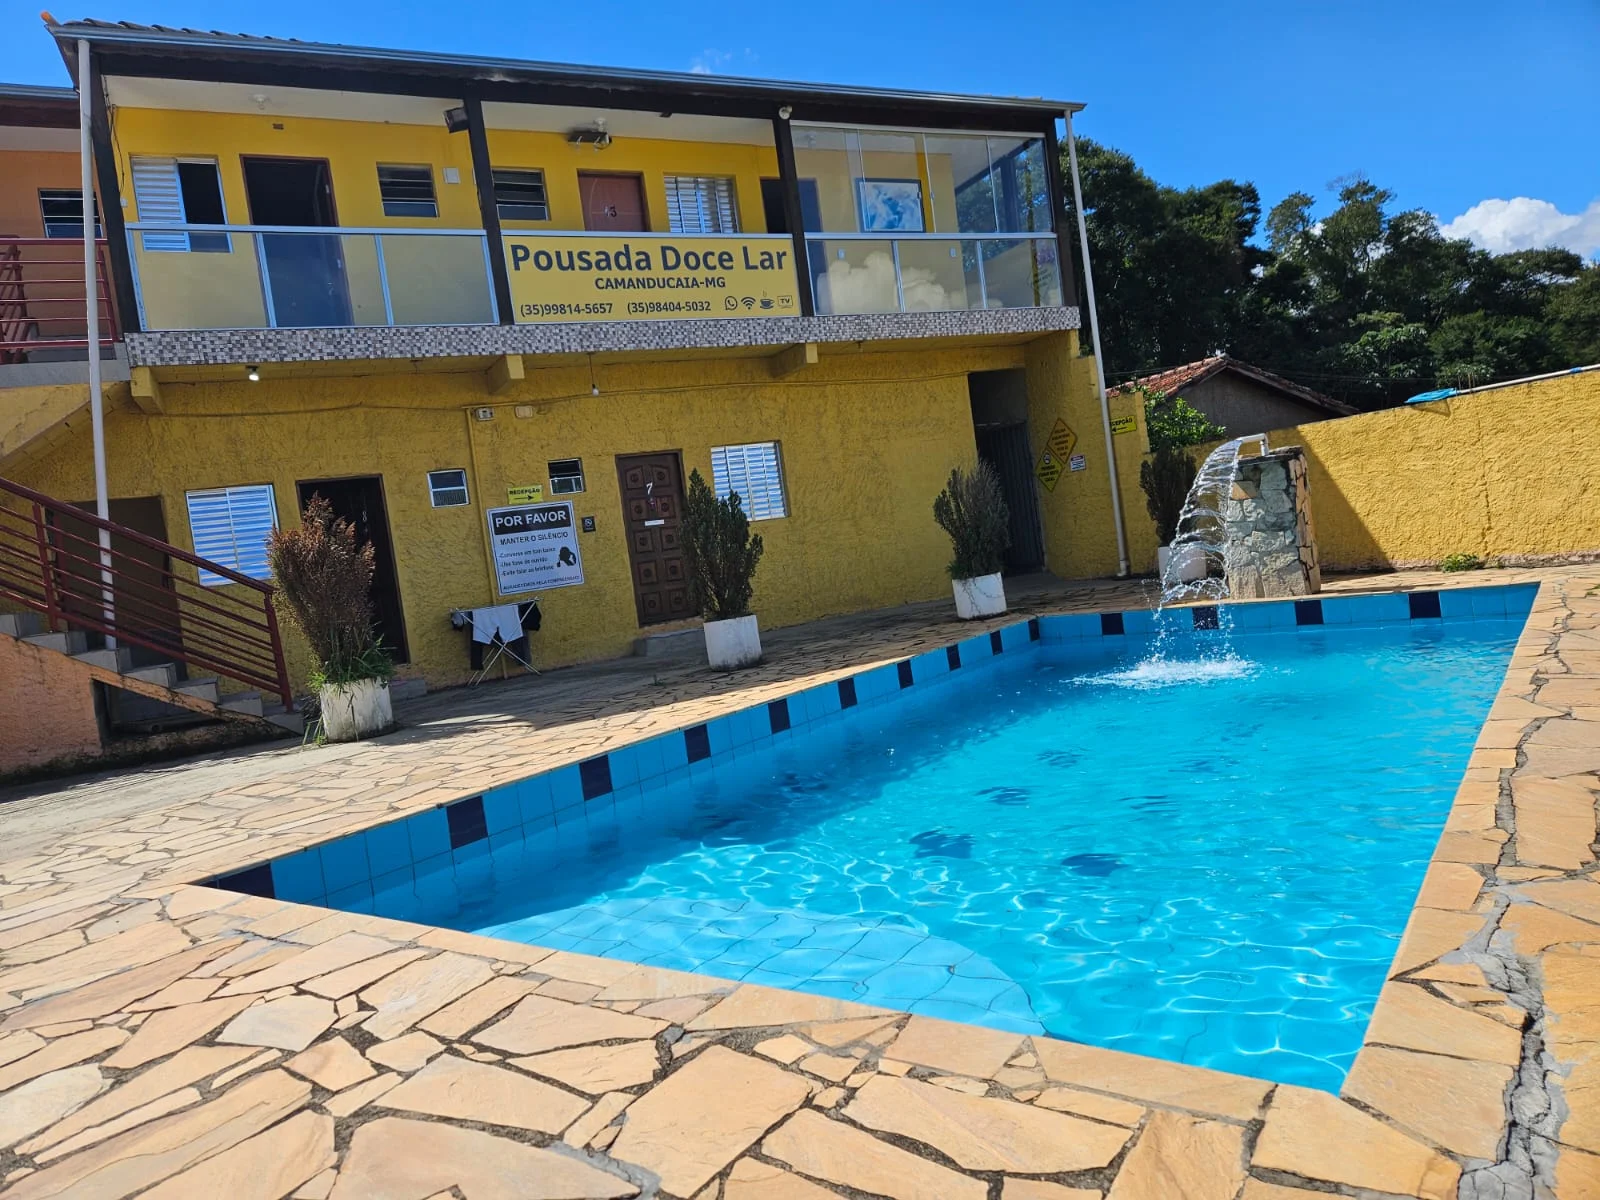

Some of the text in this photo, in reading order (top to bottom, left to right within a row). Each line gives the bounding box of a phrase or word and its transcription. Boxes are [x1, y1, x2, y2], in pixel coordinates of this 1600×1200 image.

[510, 244, 787, 272] Pousada Doce Lar
[594, 276, 726, 290] CAMANDUCAIA-MG
[520, 300, 712, 317] (35)99814-5657 (35)98404-5032
[509, 488, 540, 496] RECEPÇÃO
[646, 482, 653, 495] 7
[362, 511, 368, 522] 8
[496, 510, 567, 528] POR FAVOR
[500, 536, 529, 546] MANTER
[538, 532, 568, 541] SILÊNCIO
